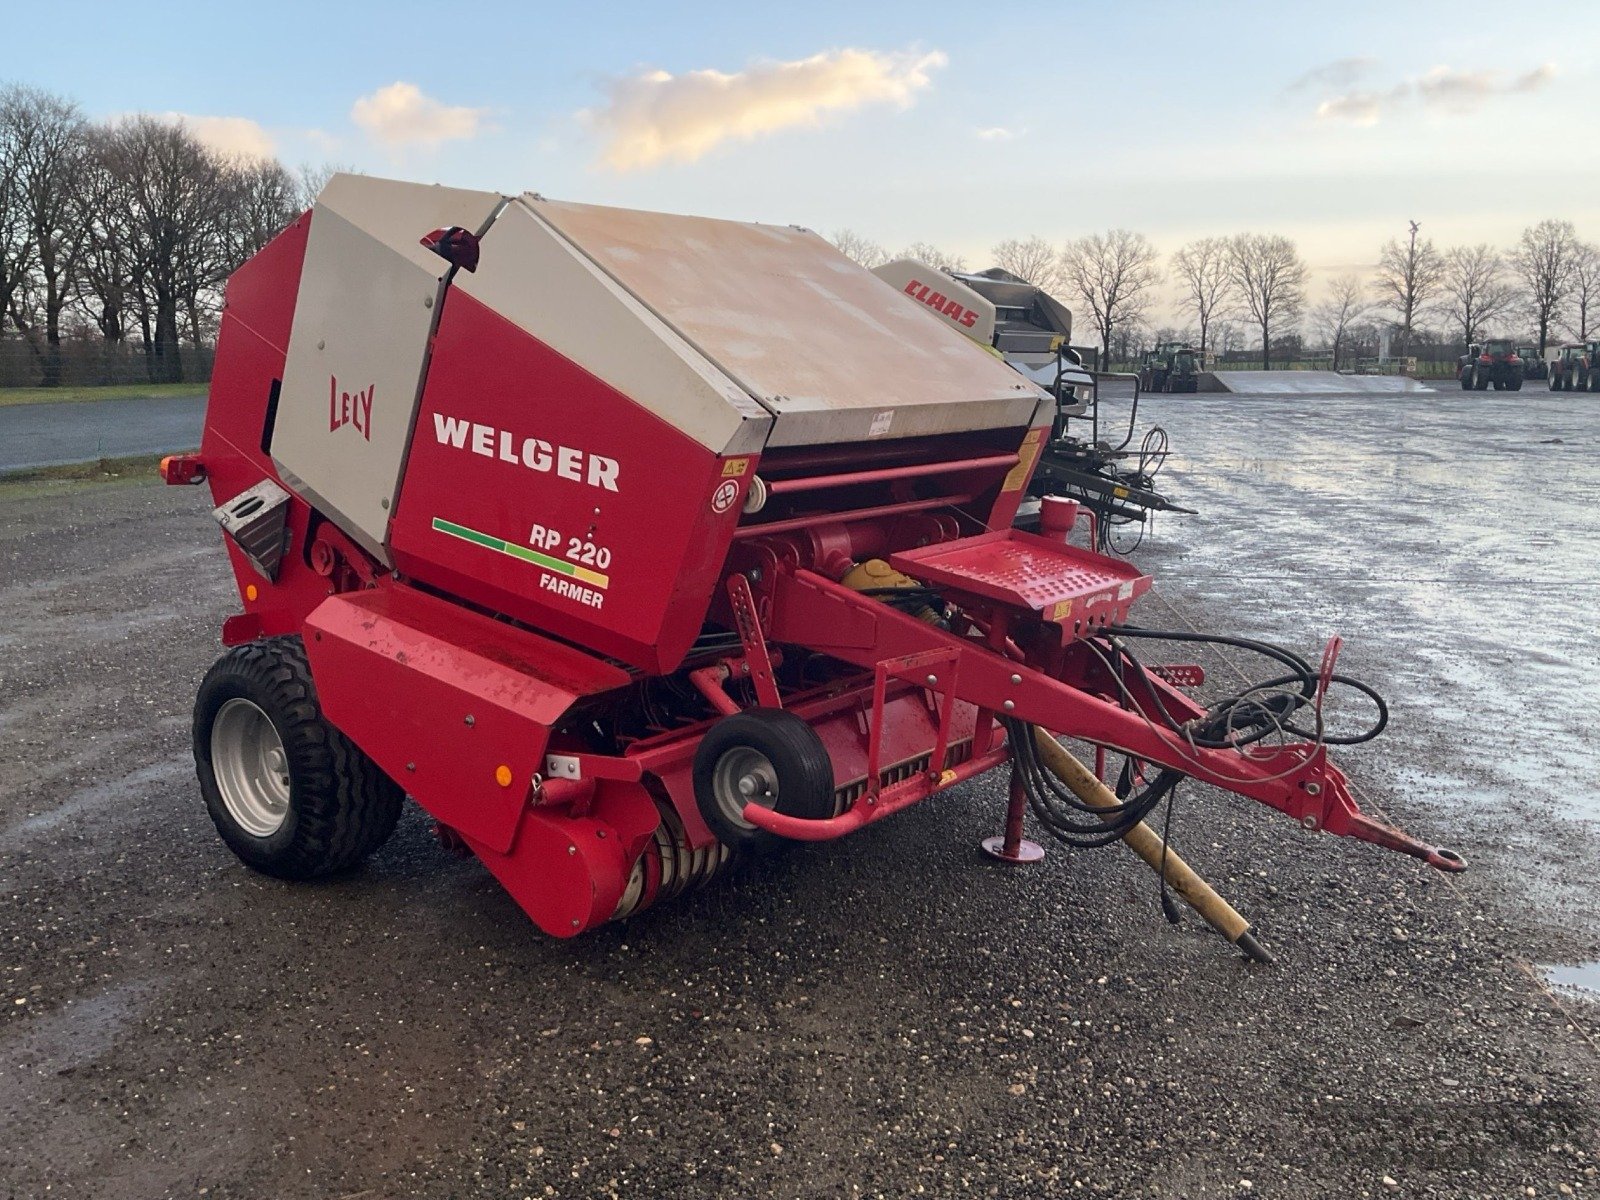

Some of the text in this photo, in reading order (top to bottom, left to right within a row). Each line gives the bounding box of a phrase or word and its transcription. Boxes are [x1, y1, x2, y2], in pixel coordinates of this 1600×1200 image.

[904, 279, 979, 328] CLAAS
[330, 374, 375, 442] LELY
[433, 413, 620, 493] WELGER
[529, 523, 611, 570] RP 220
[539, 573, 604, 609] FARMER
